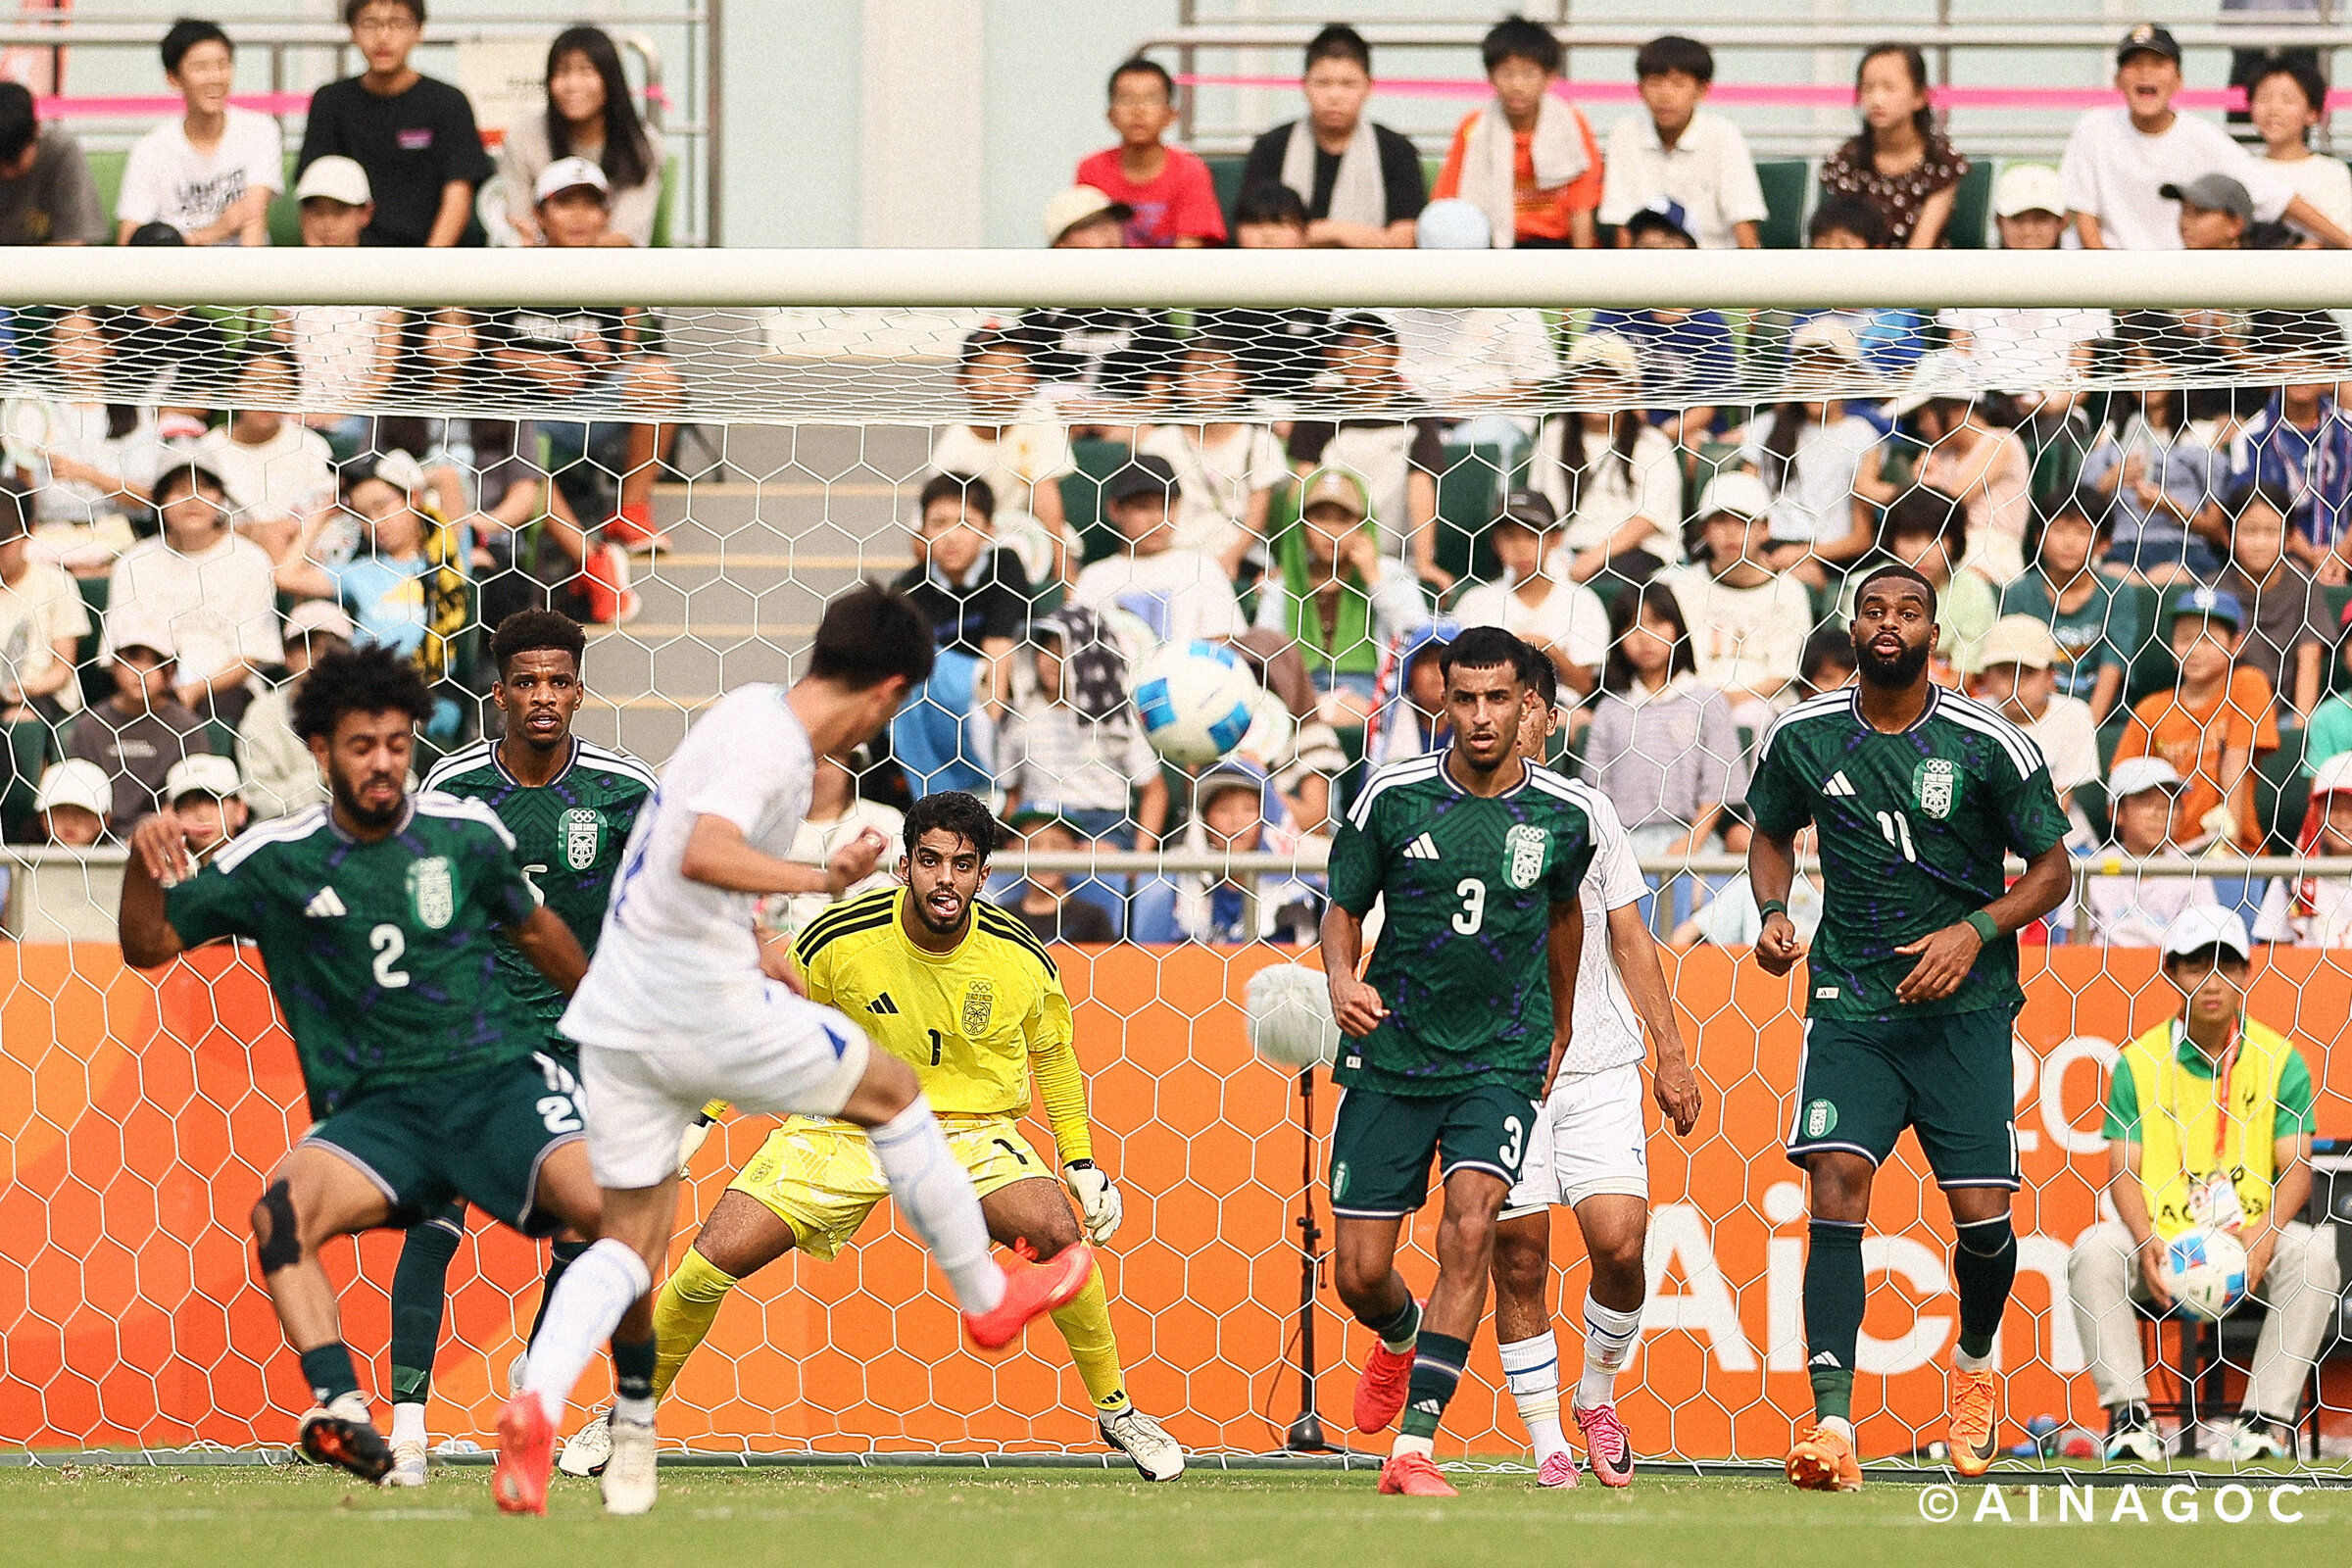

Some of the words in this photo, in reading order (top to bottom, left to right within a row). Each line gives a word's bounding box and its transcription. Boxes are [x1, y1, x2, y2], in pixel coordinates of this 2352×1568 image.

[1876, 810, 1917, 863] 11
[1451, 877, 1487, 936] 3
[369, 923, 411, 989] 2
[927, 1028, 942, 1067] 1
[535, 1095, 583, 1135] 2
[992, 1138, 1029, 1165] 1
[1498, 1115, 1523, 1170] 3
